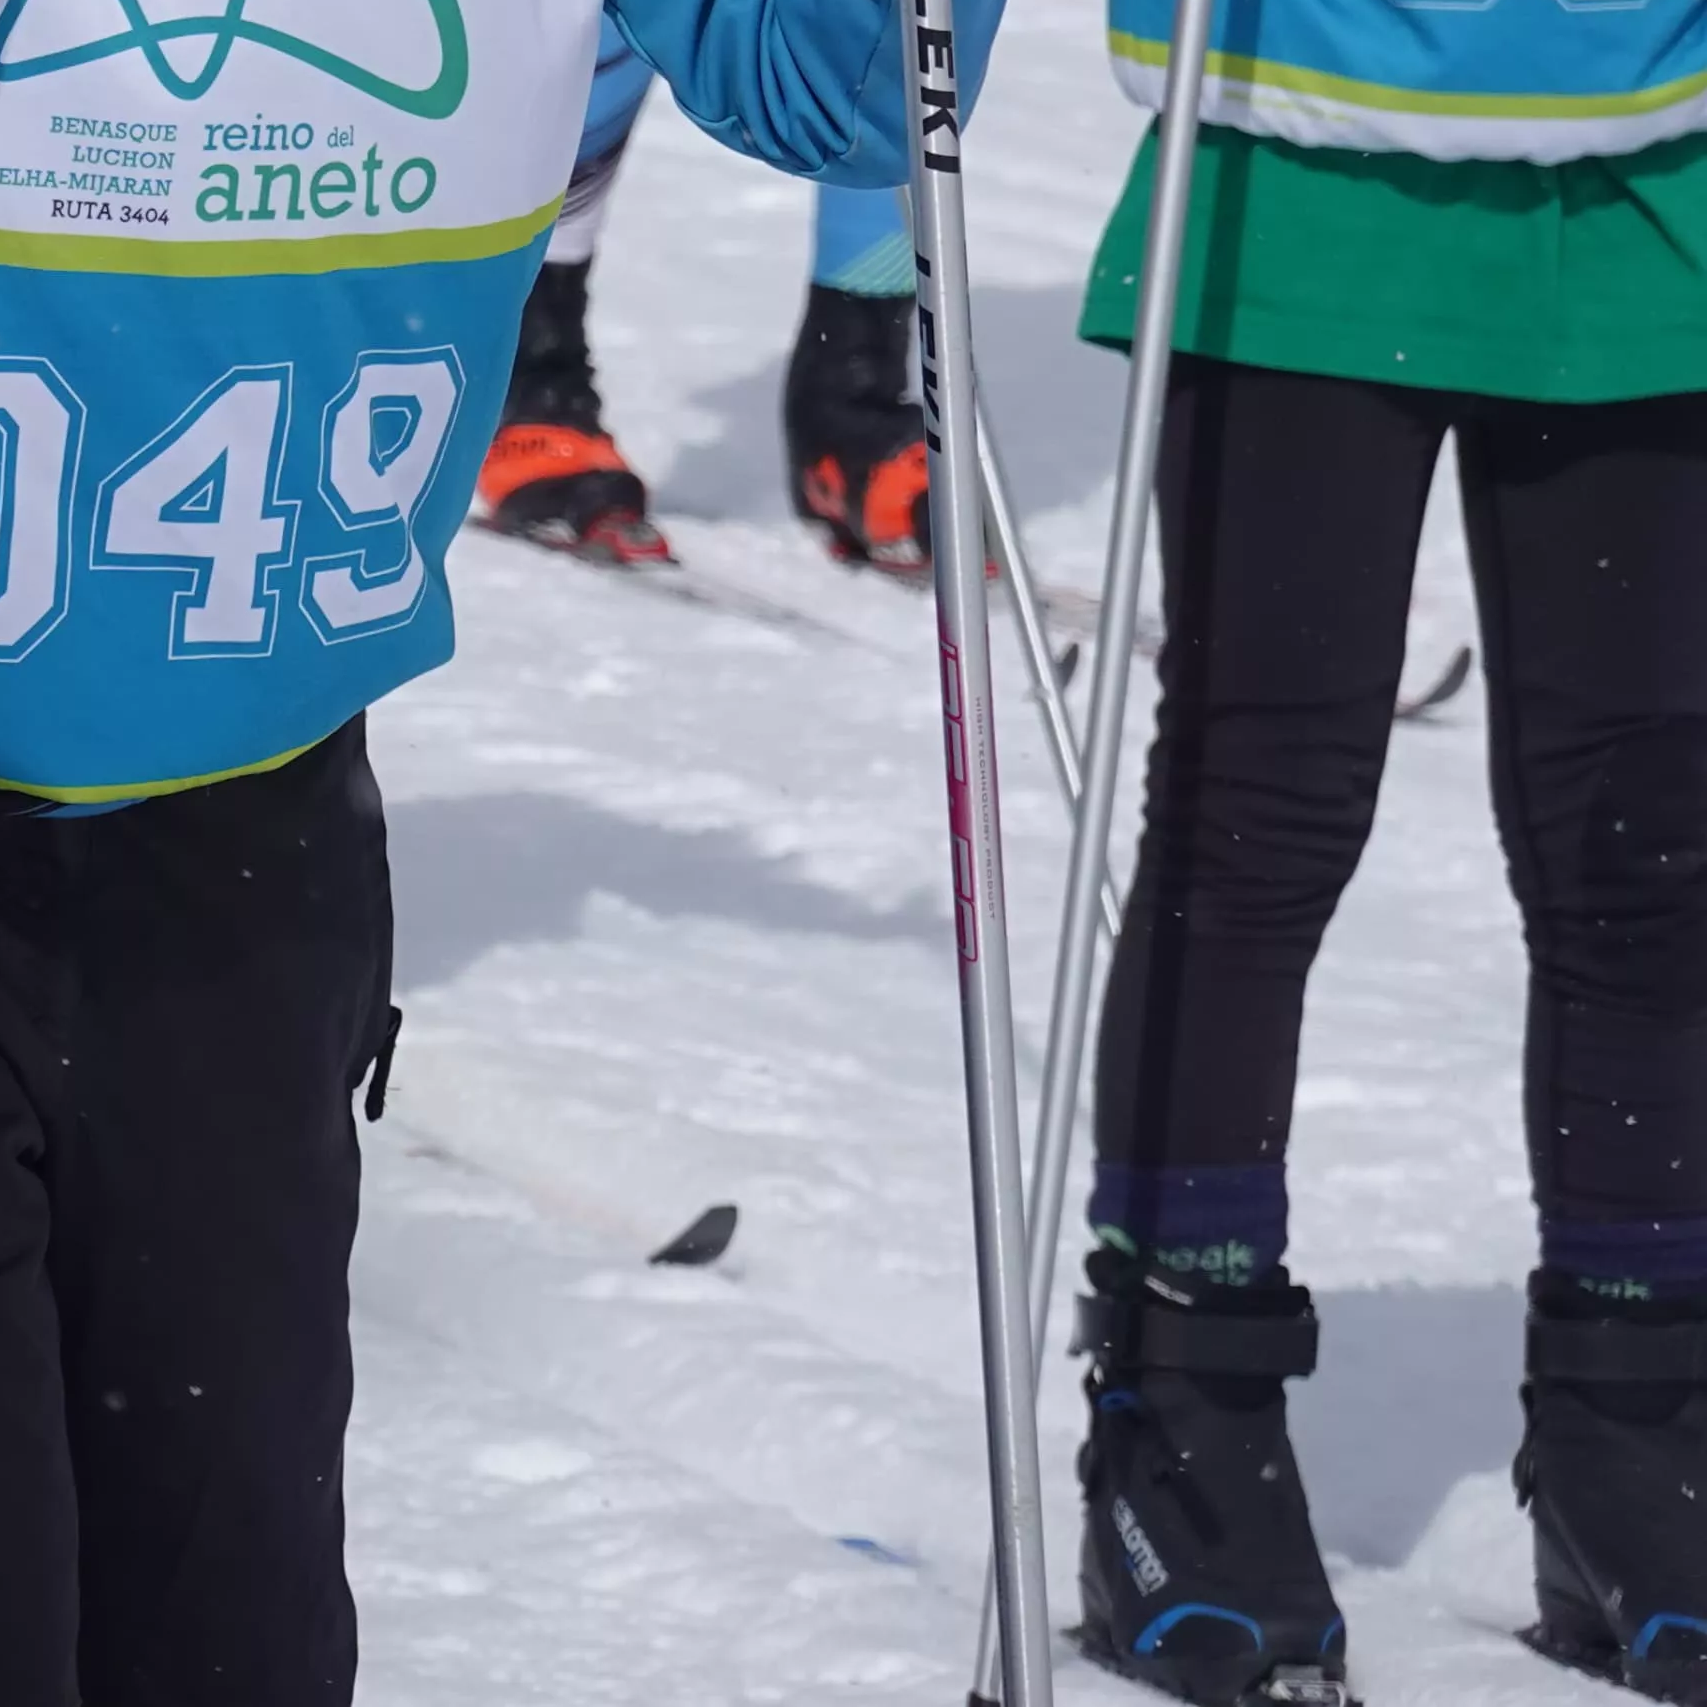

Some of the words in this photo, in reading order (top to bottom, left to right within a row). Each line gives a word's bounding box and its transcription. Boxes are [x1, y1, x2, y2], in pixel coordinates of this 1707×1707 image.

[50, 115, 177, 144] BENASQUE
[203, 113, 314, 152] reino
[327, 125, 355, 148] del
[72, 145, 175, 171] LUCHON
[195, 141, 437, 224] aneto
[51, 198, 113, 223] RUTA
[119, 205, 170, 225] 3404
